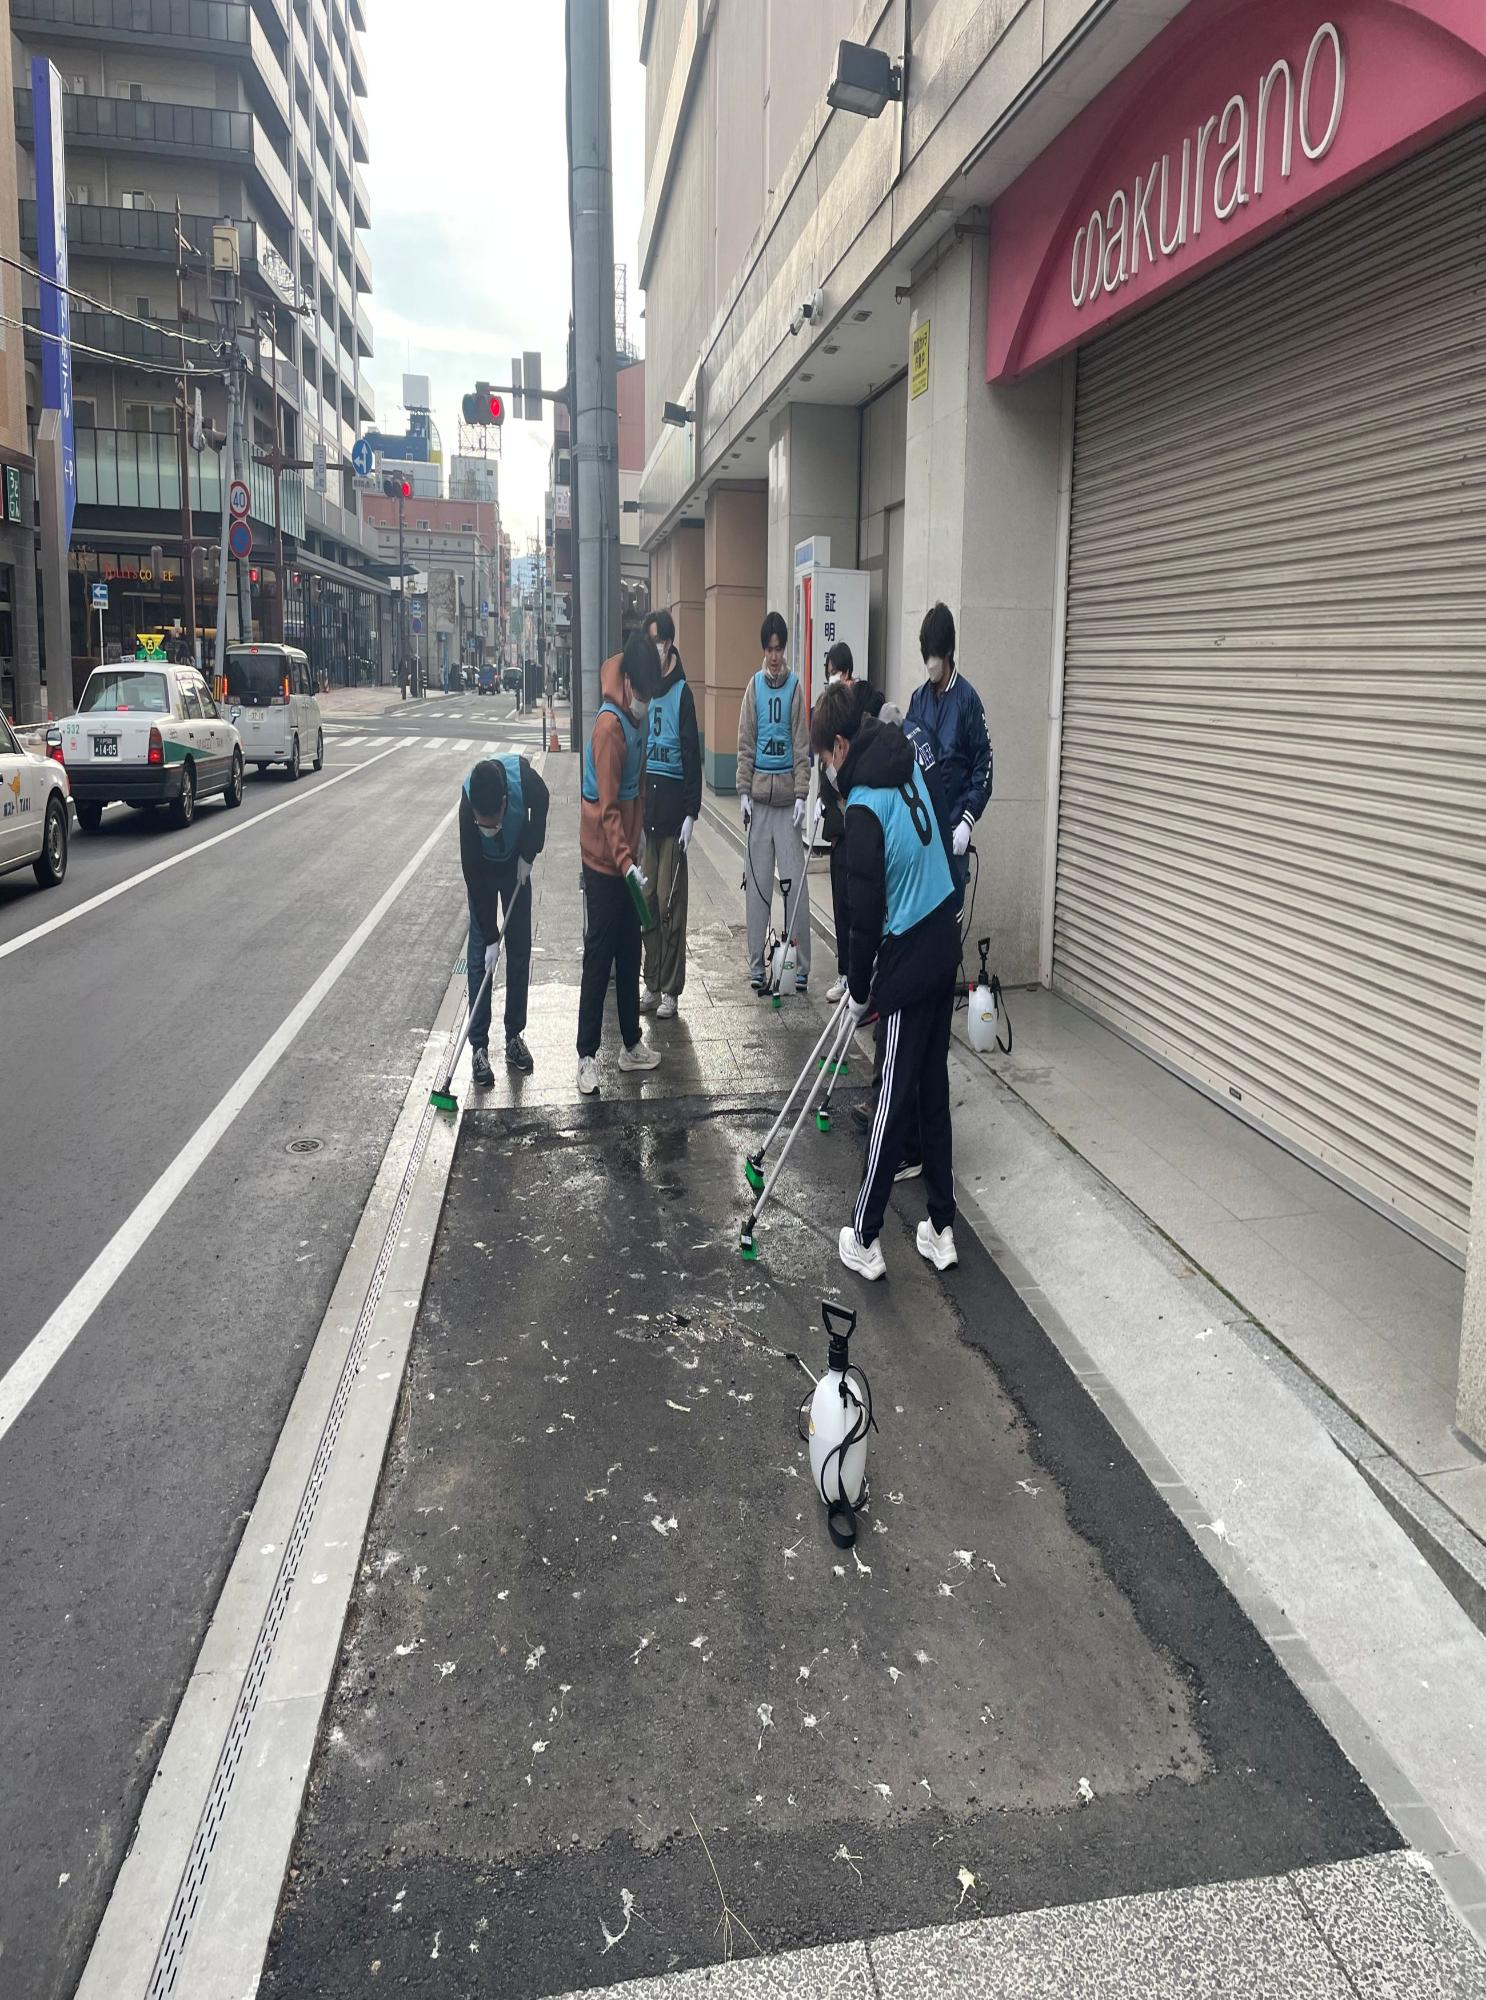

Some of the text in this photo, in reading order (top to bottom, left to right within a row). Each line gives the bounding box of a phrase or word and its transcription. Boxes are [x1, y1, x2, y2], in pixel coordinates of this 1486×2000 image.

[233, 491, 246, 509] 40
[139, 568, 174, 582] COEE
[768, 696, 782, 724] 10
[66, 723, 80, 735] 532
[653, 706, 663, 737] 5
[19, 797, 31, 812] TAXI
[898, 781, 933, 847] 8
